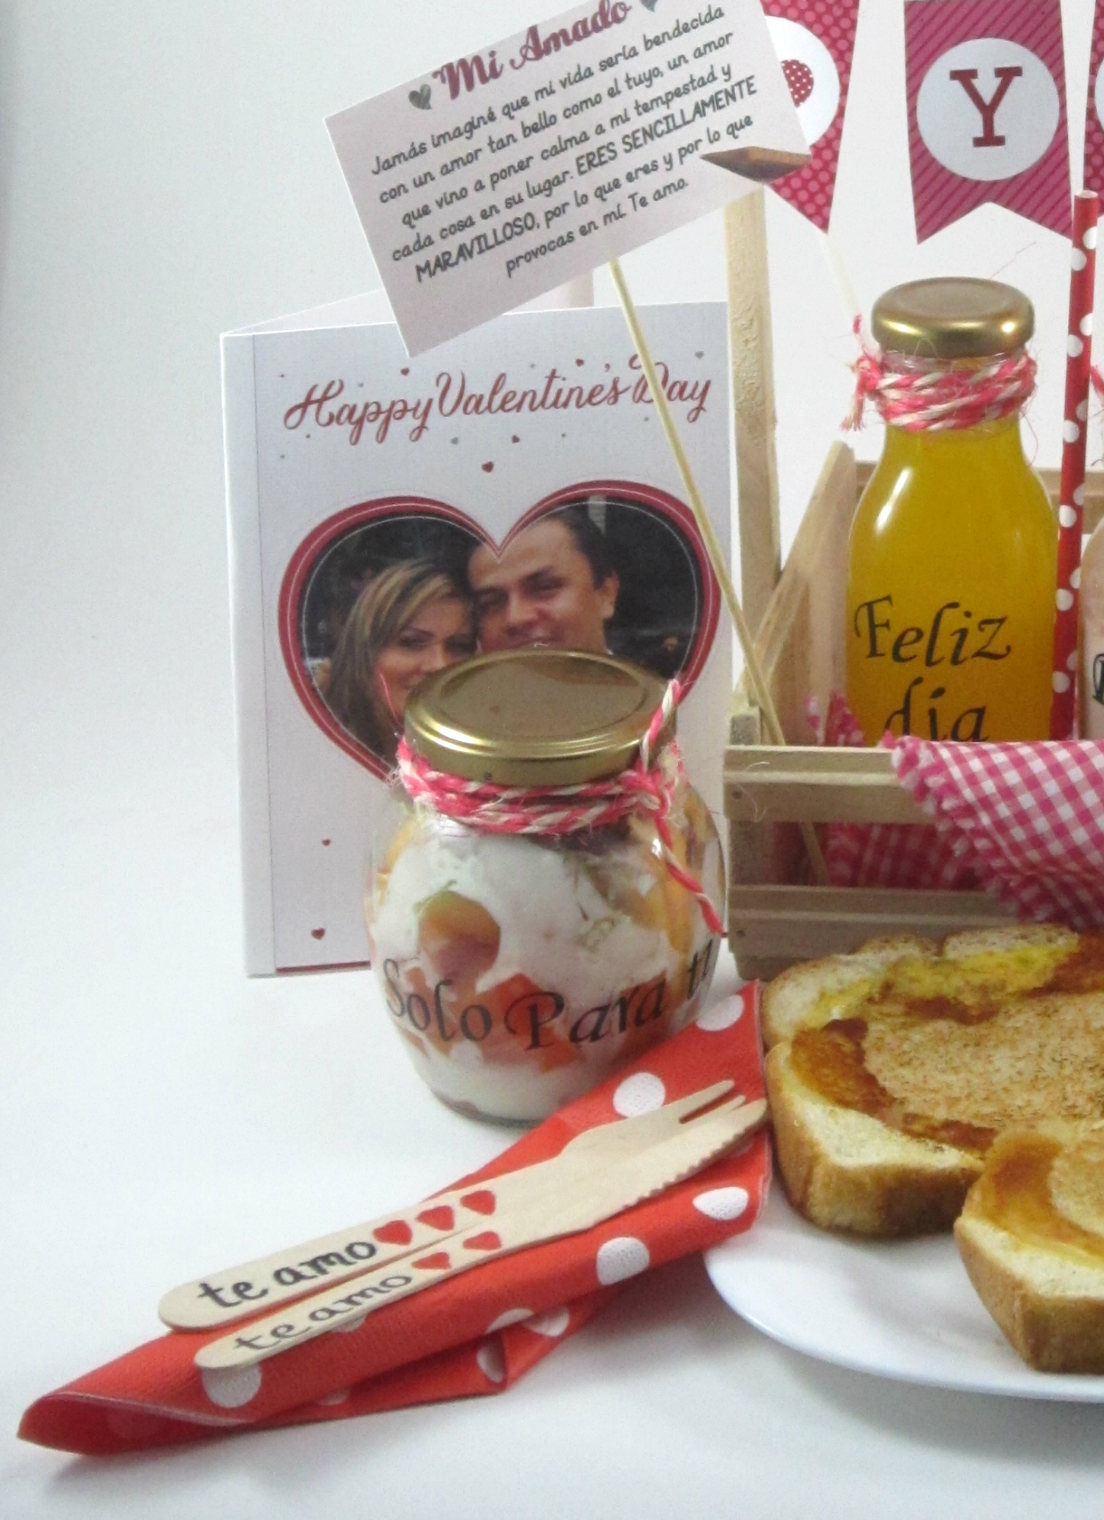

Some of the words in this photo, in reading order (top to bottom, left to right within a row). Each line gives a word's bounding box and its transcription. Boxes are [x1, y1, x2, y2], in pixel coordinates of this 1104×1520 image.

[371, 141, 428, 175] Jamás
[431, 106, 497, 148] imaginé
[501, 96, 530, 120] que
[534, 80, 556, 101] mi
[559, 64, 594, 89] vida
[643, 4, 725, 51] bendecida
[379, 183, 409, 204] con
[413, 171, 435, 188] un
[440, 148, 482, 176] amor
[487, 132, 518, 153] tan
[521, 111, 558, 139] bello
[562, 92, 602, 120] como
[607, 78, 621, 98] el
[625, 65, 664, 91] tuyo,
[667, 53, 689, 71] un
[693, 30, 733, 60] amor
[432, 50, 503, 100] Mi
[392, 232, 434, 261] cada
[439, 215, 476, 239] cosa
[479, 203, 500, 220] en
[504, 193, 525, 209] su
[526, 169, 574, 198] lugar.
[575, 141, 618, 176] ERES
[621, 74, 758, 154] SENCILLAMENTE
[402, 204, 431, 229] que
[435, 186, 469, 209] vino
[473, 179, 486, 193] a
[490, 155, 534, 191] poner
[540, 129, 591, 161] calma
[594, 122, 606, 136] a
[633, 63, 718, 117] tempestad
[721, 63, 732, 80] y
[415, 212, 540, 283] MARAVILLOSO,
[544, 201, 570, 229] por
[573, 190, 588, 208] lo
[594, 178, 622, 202] que
[625, 160, 658, 183] eres
[663, 152, 674, 172] y
[678, 138, 703, 165] por
[706, 127, 721, 145] lo
[726, 114, 754, 140] que
[505, 230, 576, 278] provocas
[579, 220, 599, 237] en
[627, 191, 649, 212] Te
[653, 177, 689, 202] amo.
[283, 378, 434, 446] Happy
[435, 363, 631, 418] Valentine's
[628, 353, 712, 423] Day
[854, 595, 1012, 668] Feliz
[383, 958, 493, 1043] Solo
[504, 970, 668, 1053] Para
[198, 1281, 269, 1308] te
[273, 1241, 377, 1286] amo
[233, 1324, 311, 1350] te
[308, 1275, 413, 1322] amo
